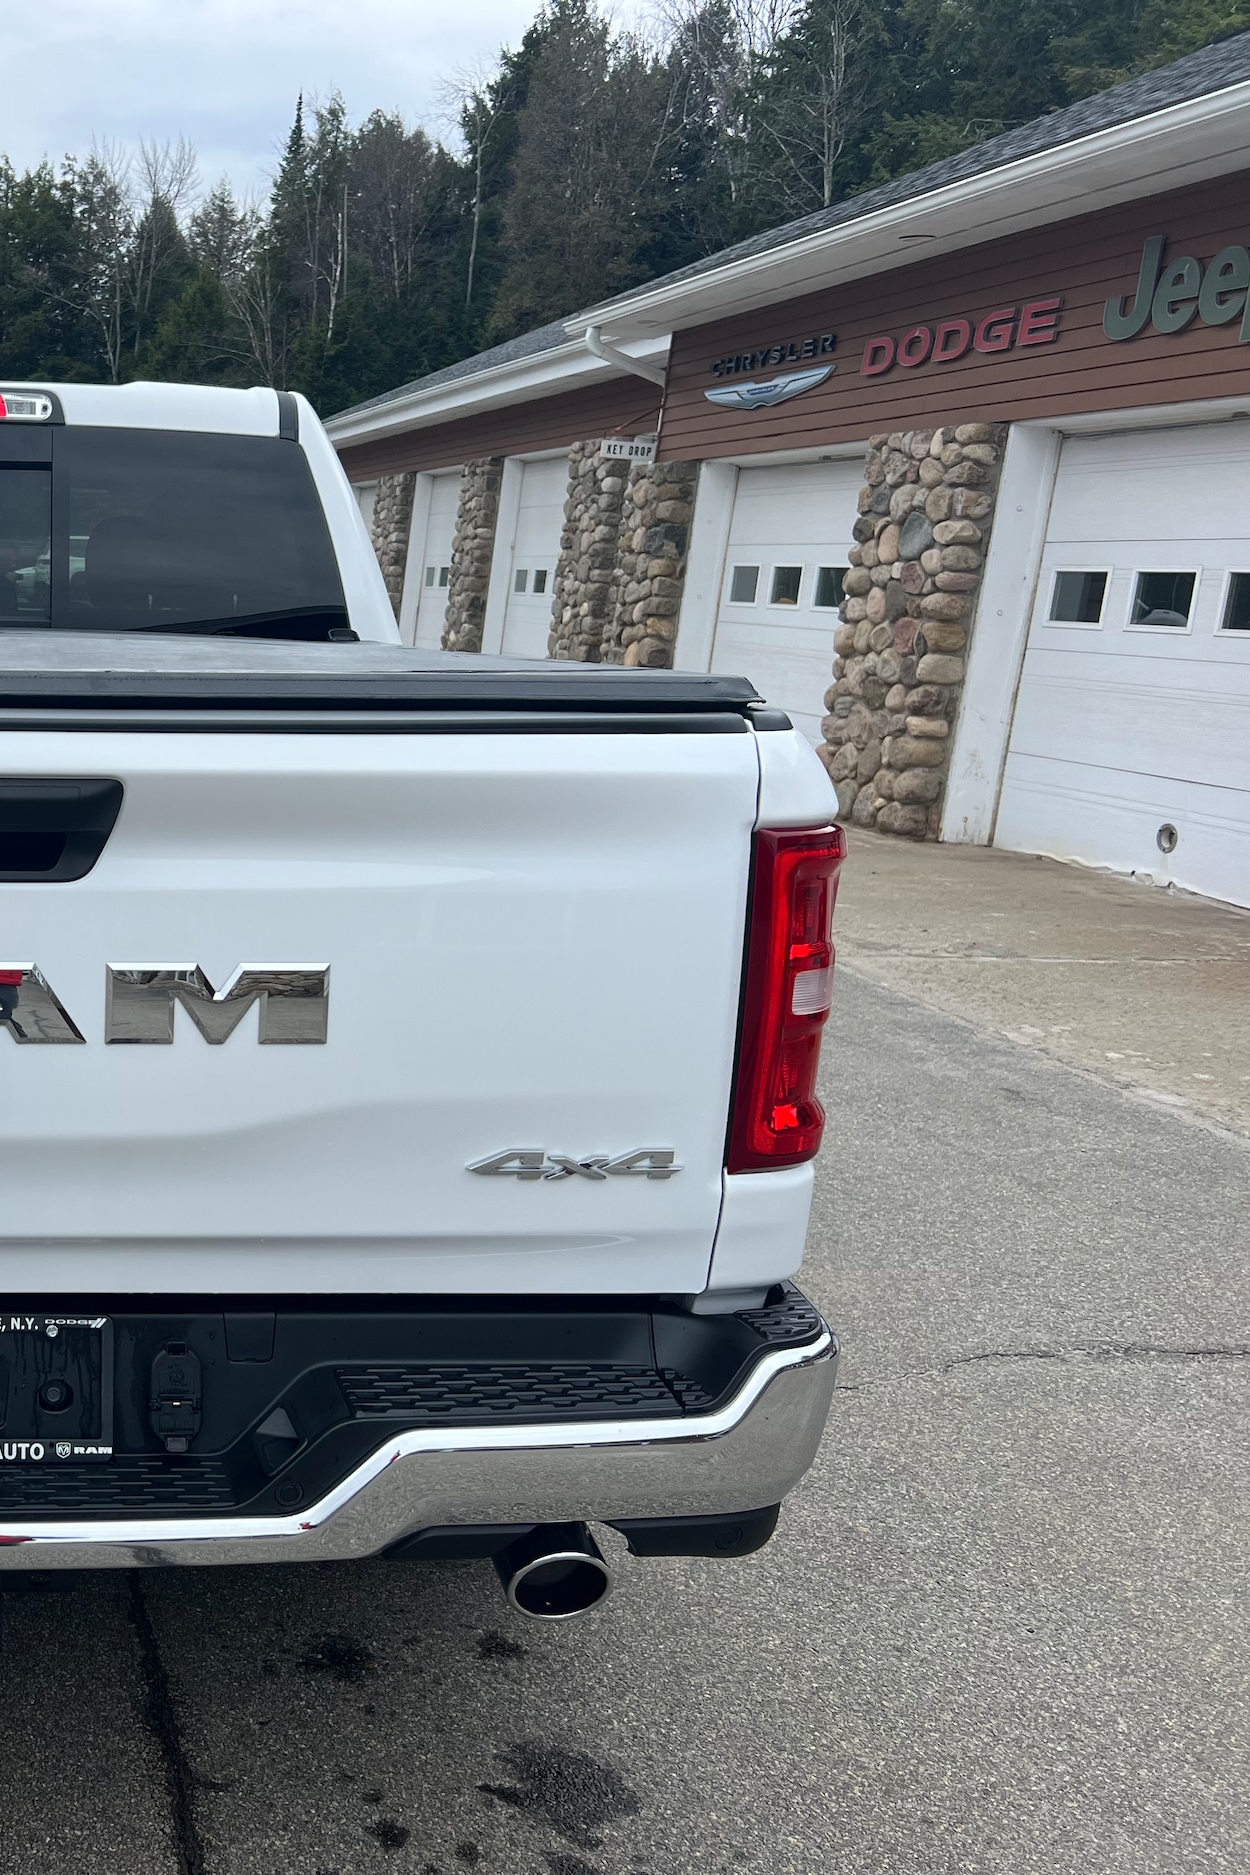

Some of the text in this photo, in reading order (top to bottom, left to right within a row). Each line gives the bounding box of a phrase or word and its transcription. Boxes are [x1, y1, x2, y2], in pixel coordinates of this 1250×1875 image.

[1103, 234, 1250, 344] Jee
[859, 297, 1066, 377] DODGE
[710, 333, 837, 378] CHRYSLER
[606, 444, 652, 457] KEY DROP
[465, 1147, 684, 1180] 4x4
[10, 1317, 39, 1330] N.Y.
[73, 1445, 113, 1455] RAM
